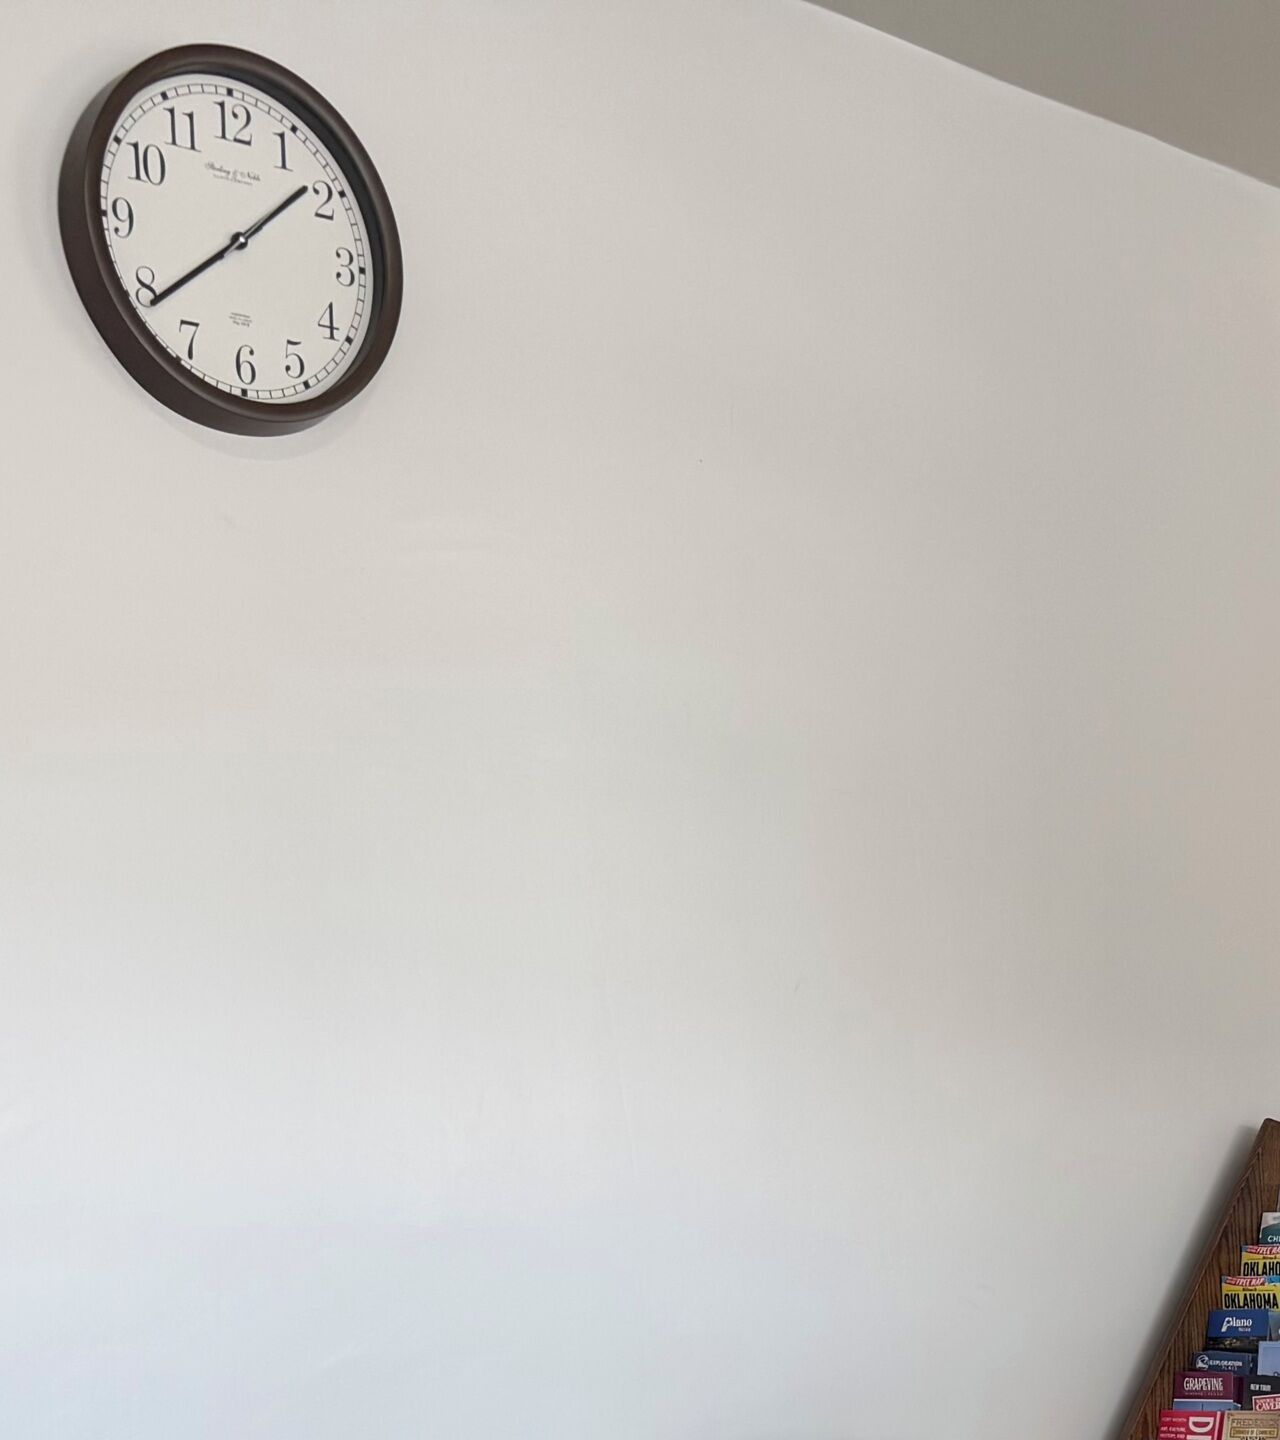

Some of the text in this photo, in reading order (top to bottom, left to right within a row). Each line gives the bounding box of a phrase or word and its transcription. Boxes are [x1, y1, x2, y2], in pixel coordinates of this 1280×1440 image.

[163, 106, 202, 153] 11
[213, 100, 253, 147] 12
[126, 140, 167, 186] 10
[273, 131, 294, 173] 1
[111, 196, 135, 239] 9
[312, 180, 335, 221] 2
[135, 265, 158, 308] 8
[335, 246, 355, 287] 3
[178, 318, 201, 361] 7
[317, 301, 341, 342] 4
[235, 344, 257, 385] 6
[284, 339, 306, 380] 5
[1224, 1293, 1279, 1310] OKLAHOMA
[1183, 1377, 1224, 1391] GRAPEVINE
